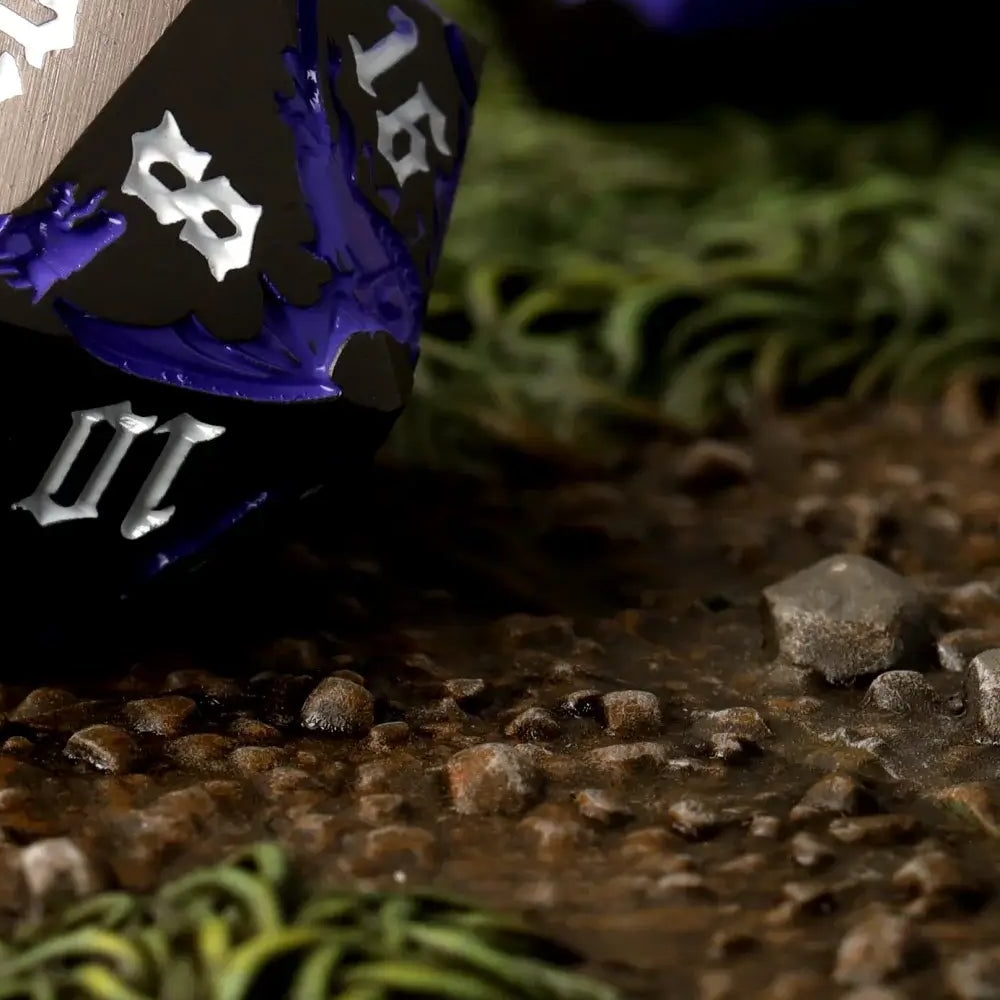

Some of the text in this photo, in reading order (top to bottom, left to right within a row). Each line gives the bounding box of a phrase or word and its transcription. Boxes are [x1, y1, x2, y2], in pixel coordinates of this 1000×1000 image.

[347, 5, 452, 188] 16
[120, 110, 262, 283] 8
[11, 400, 227, 540] 10
